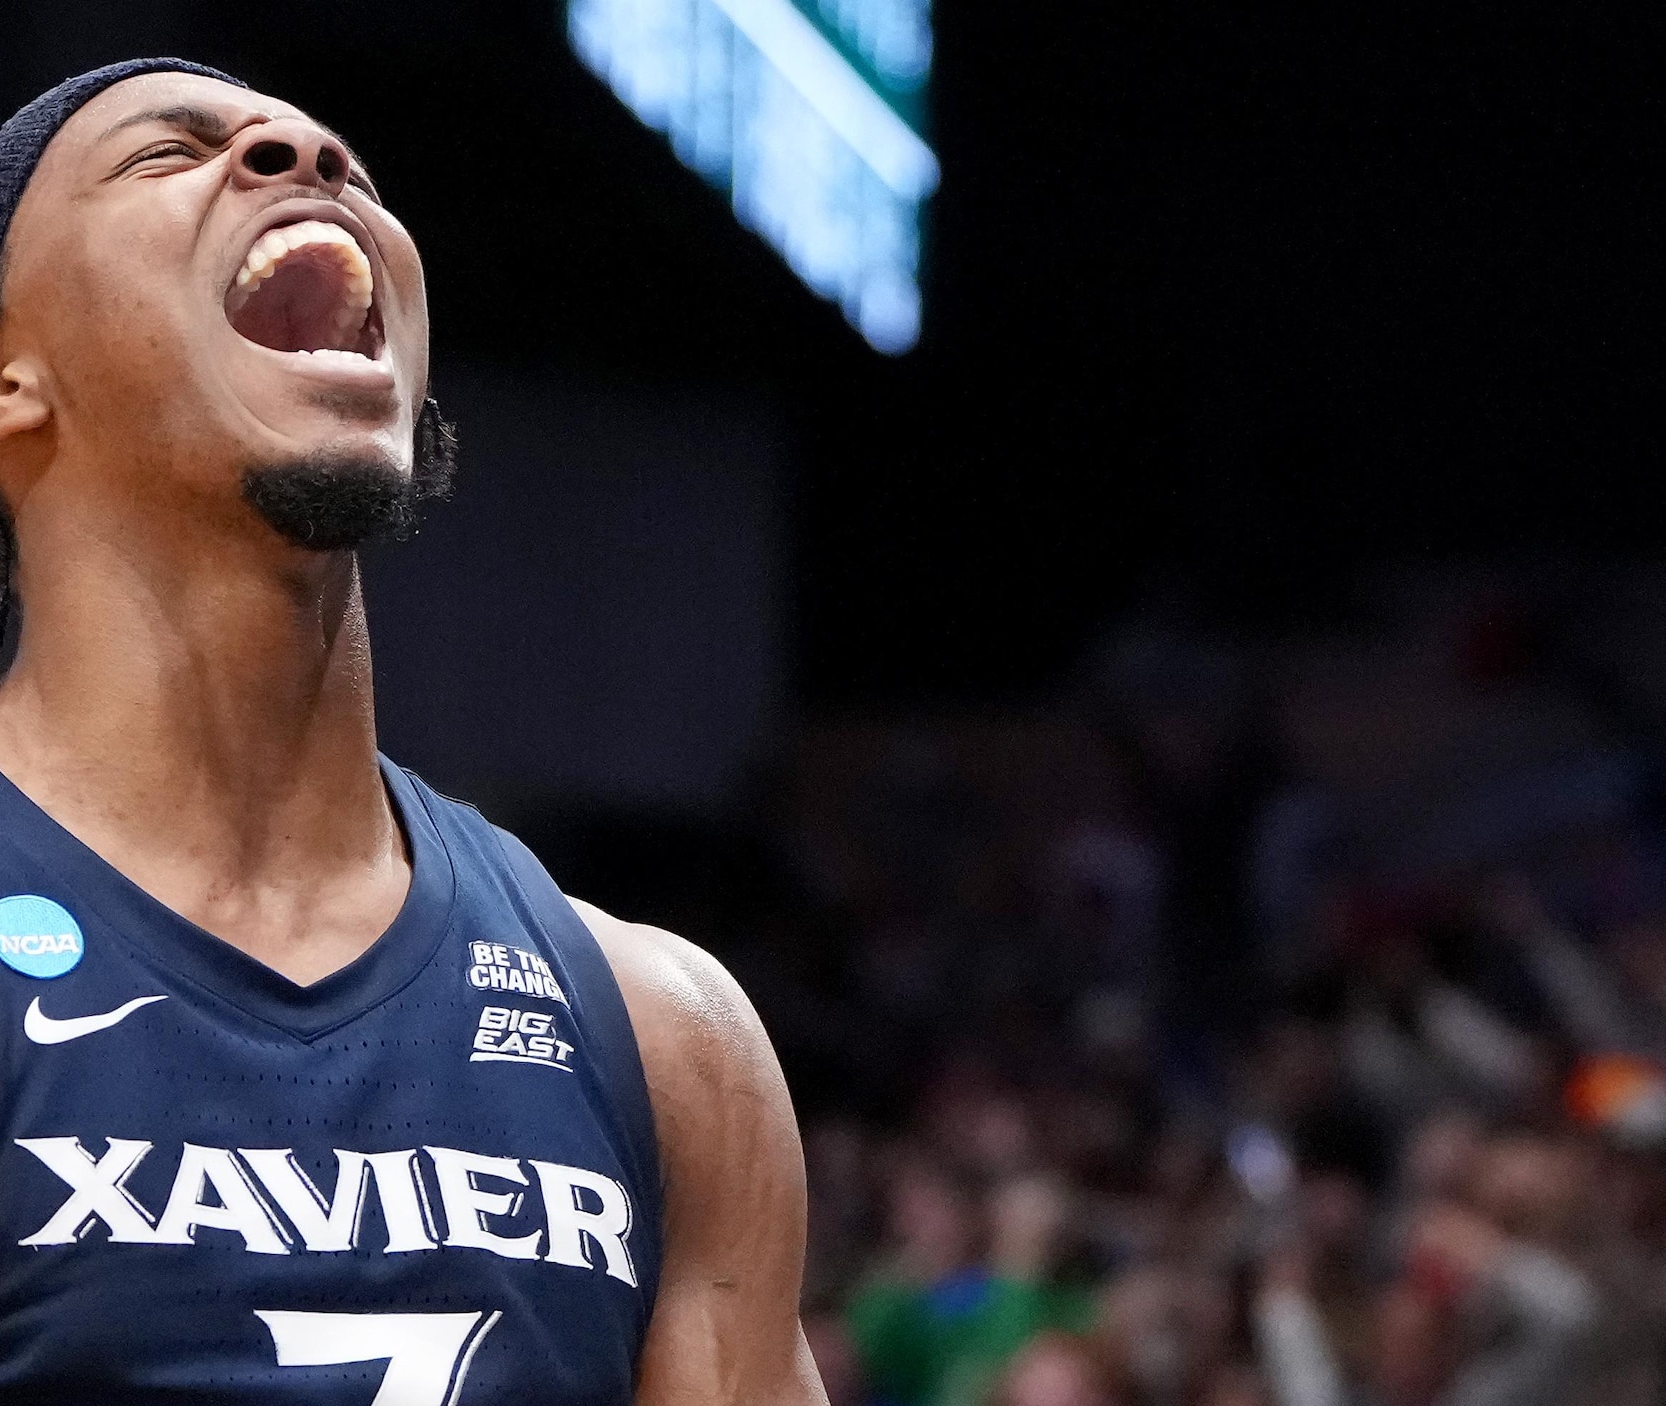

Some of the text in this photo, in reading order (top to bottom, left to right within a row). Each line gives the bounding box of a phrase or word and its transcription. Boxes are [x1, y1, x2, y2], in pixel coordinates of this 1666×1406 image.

[473, 944, 551, 976] BE TH
[469, 965, 567, 1000] CHANG
[478, 1006, 553, 1036] BIG
[472, 1029, 575, 1062] EAST
[13, 1135, 639, 1289] XAVIER
